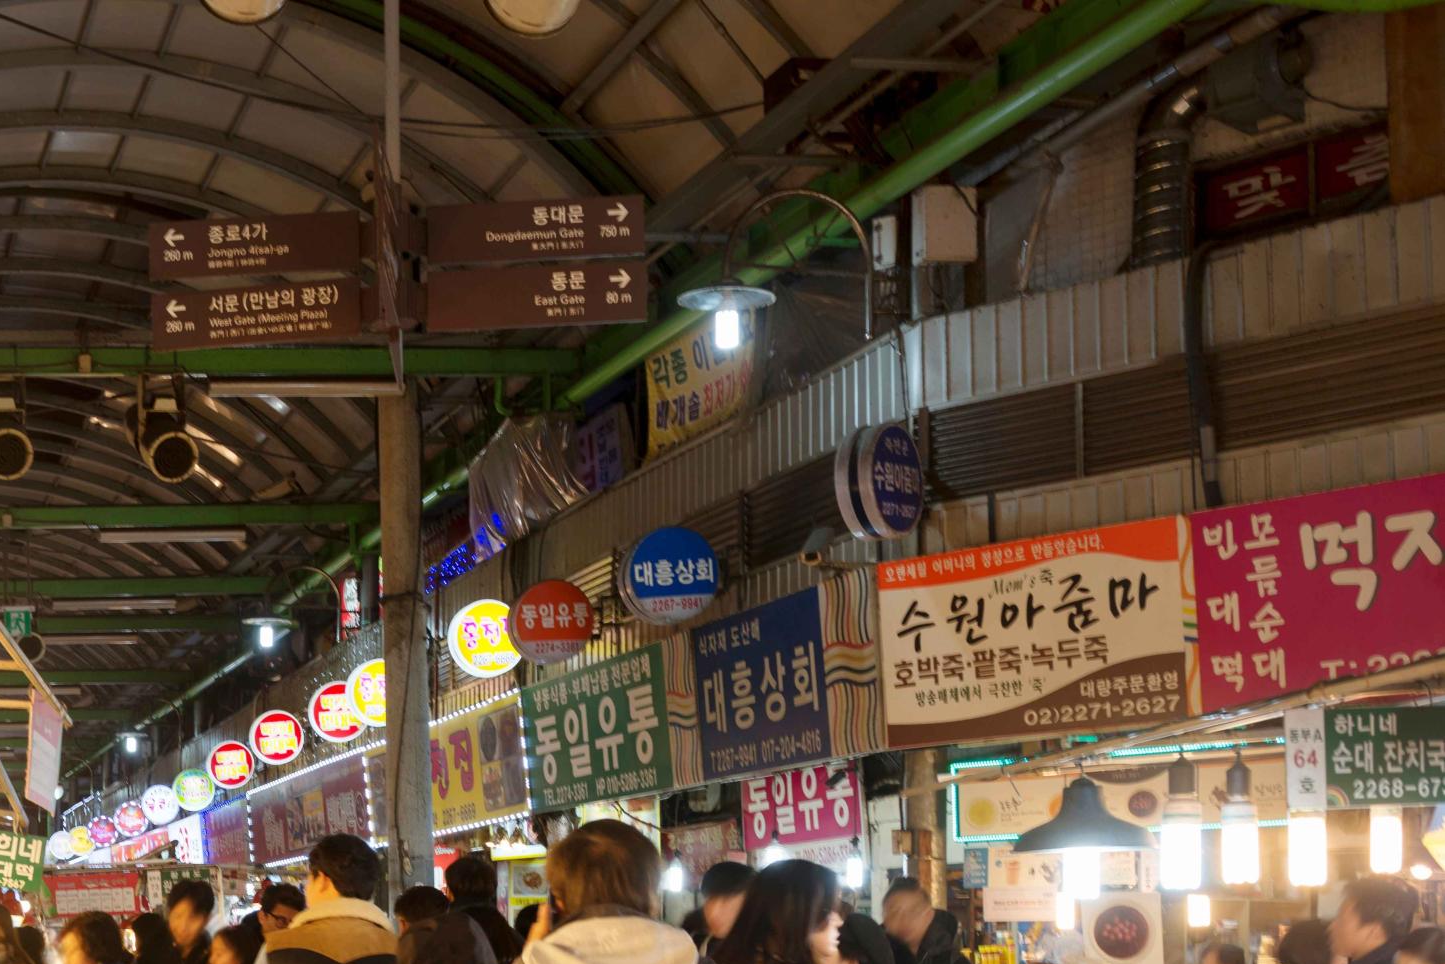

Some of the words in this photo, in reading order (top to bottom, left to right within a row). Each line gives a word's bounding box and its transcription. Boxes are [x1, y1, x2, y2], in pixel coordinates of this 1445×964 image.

[532, 204, 585, 226] 동대문
[207, 222, 269, 244] 종로4가
[485, 228, 556, 243] Dongdaemun
[558, 226, 585, 239] Gate
[163, 250, 181, 262] 260
[207, 246, 247, 259] Jongno
[551, 270, 586, 291] 동문
[208, 295, 240, 313] 서문
[242, 289, 295, 312] (만남의
[301, 284, 339, 306] 광장)
[534, 294, 557, 306] East
[559, 293, 585, 306] Gate
[165, 321, 183, 333] 260
[208, 316, 233, 328] West
[234, 314, 256, 326] Gate
[300, 308, 328, 320] Plaza)
[932, 554, 976, 575] 어머니의
[980, 546, 1026, 568] 정성으로
[1030, 533, 1105, 561] 만들었습니다.
[633, 557, 715, 587] 대흥상회
[520, 602, 588, 630] 동일유통
[897, 571, 1160, 653] 수원아줌마
[1202, 518, 1246, 693] 빈대떡
[703, 640, 820, 734] 대흥상회
[1079, 670, 1179, 699] 대량주문환영
[1023, 694, 1181, 727] 02)2271-2627
[534, 683, 659, 785] 동일유통
[1333, 712, 1398, 737] 하니네
[1293, 749, 1318, 768] 64
[1299, 777, 1317, 794] 호
[747, 761, 854, 840] 동일유통
